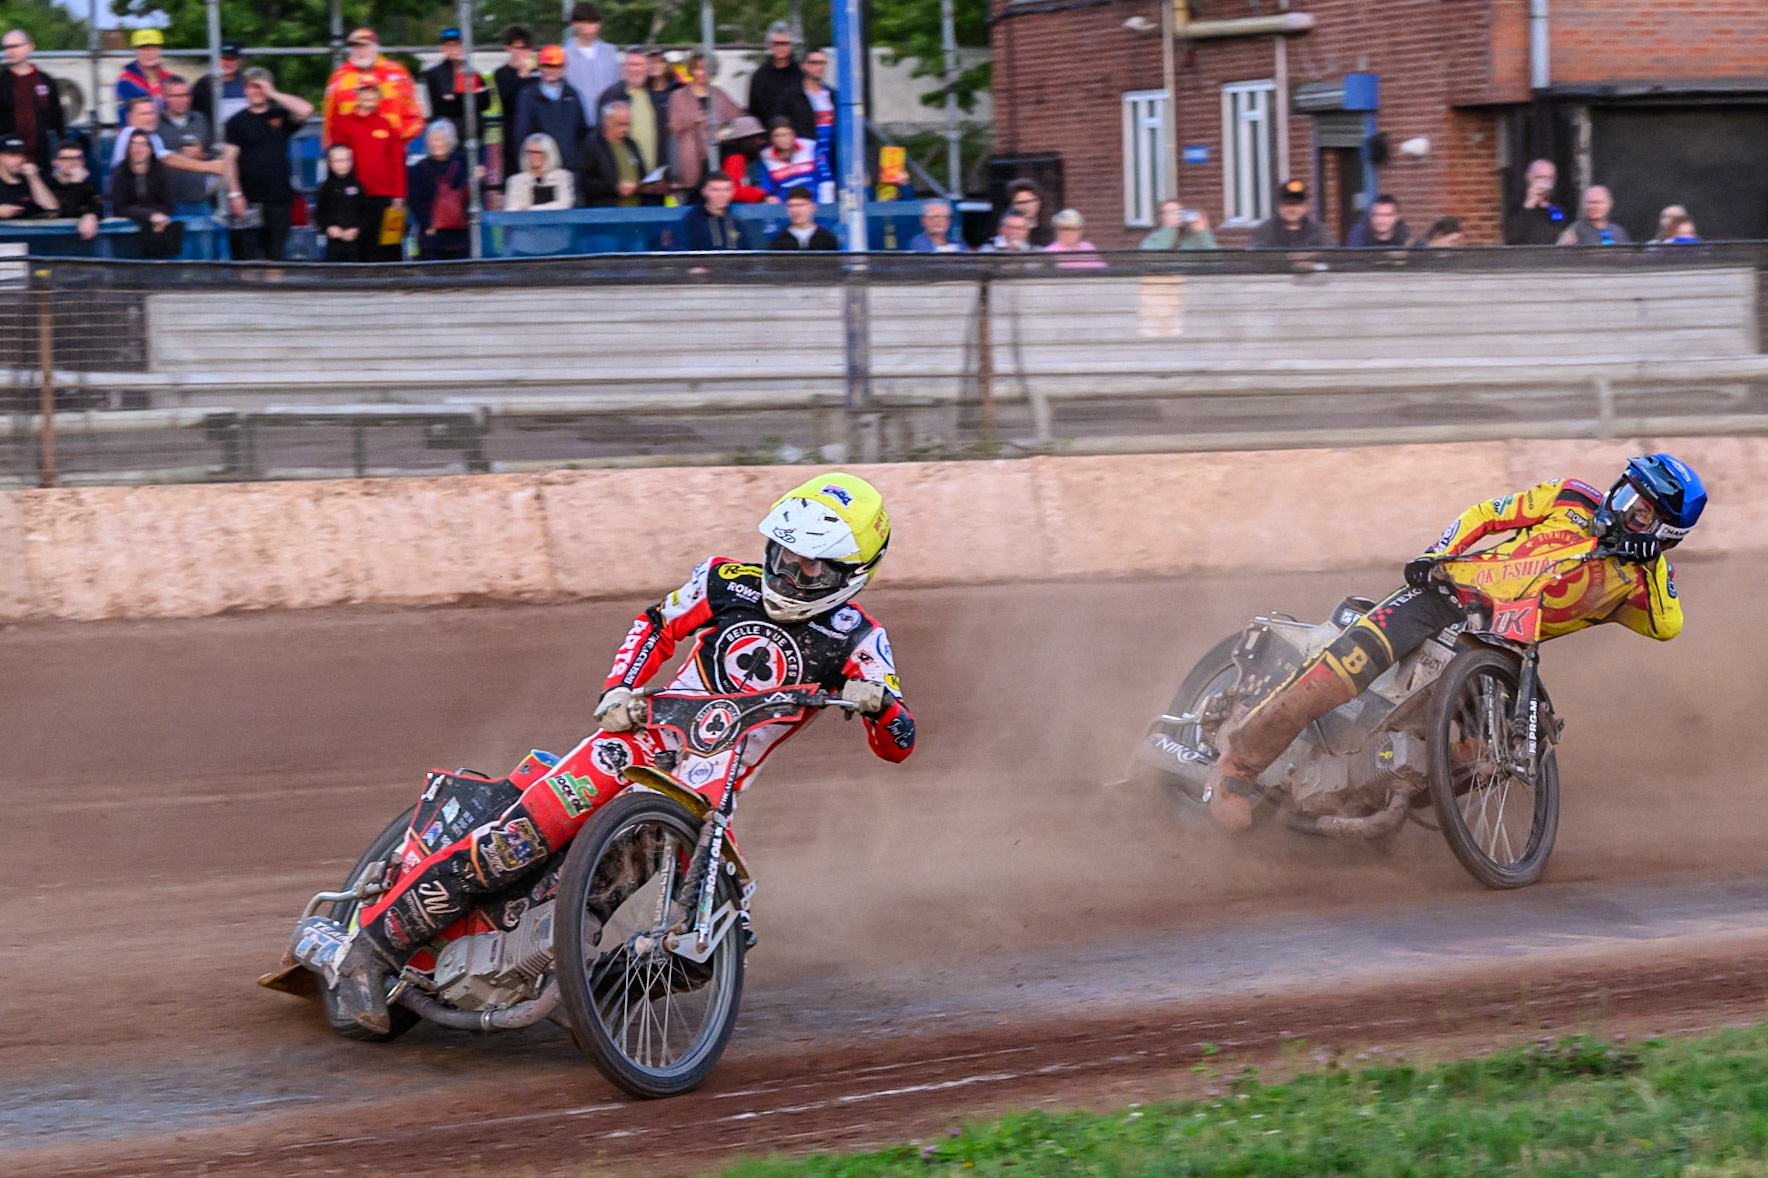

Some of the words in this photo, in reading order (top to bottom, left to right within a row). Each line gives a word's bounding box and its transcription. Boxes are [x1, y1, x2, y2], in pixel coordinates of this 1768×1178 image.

[727, 582, 761, 600] ROWE
[726, 626, 760, 642] BELLE
[765, 628, 788, 647] VUE
[784, 650, 799, 678] ACES
